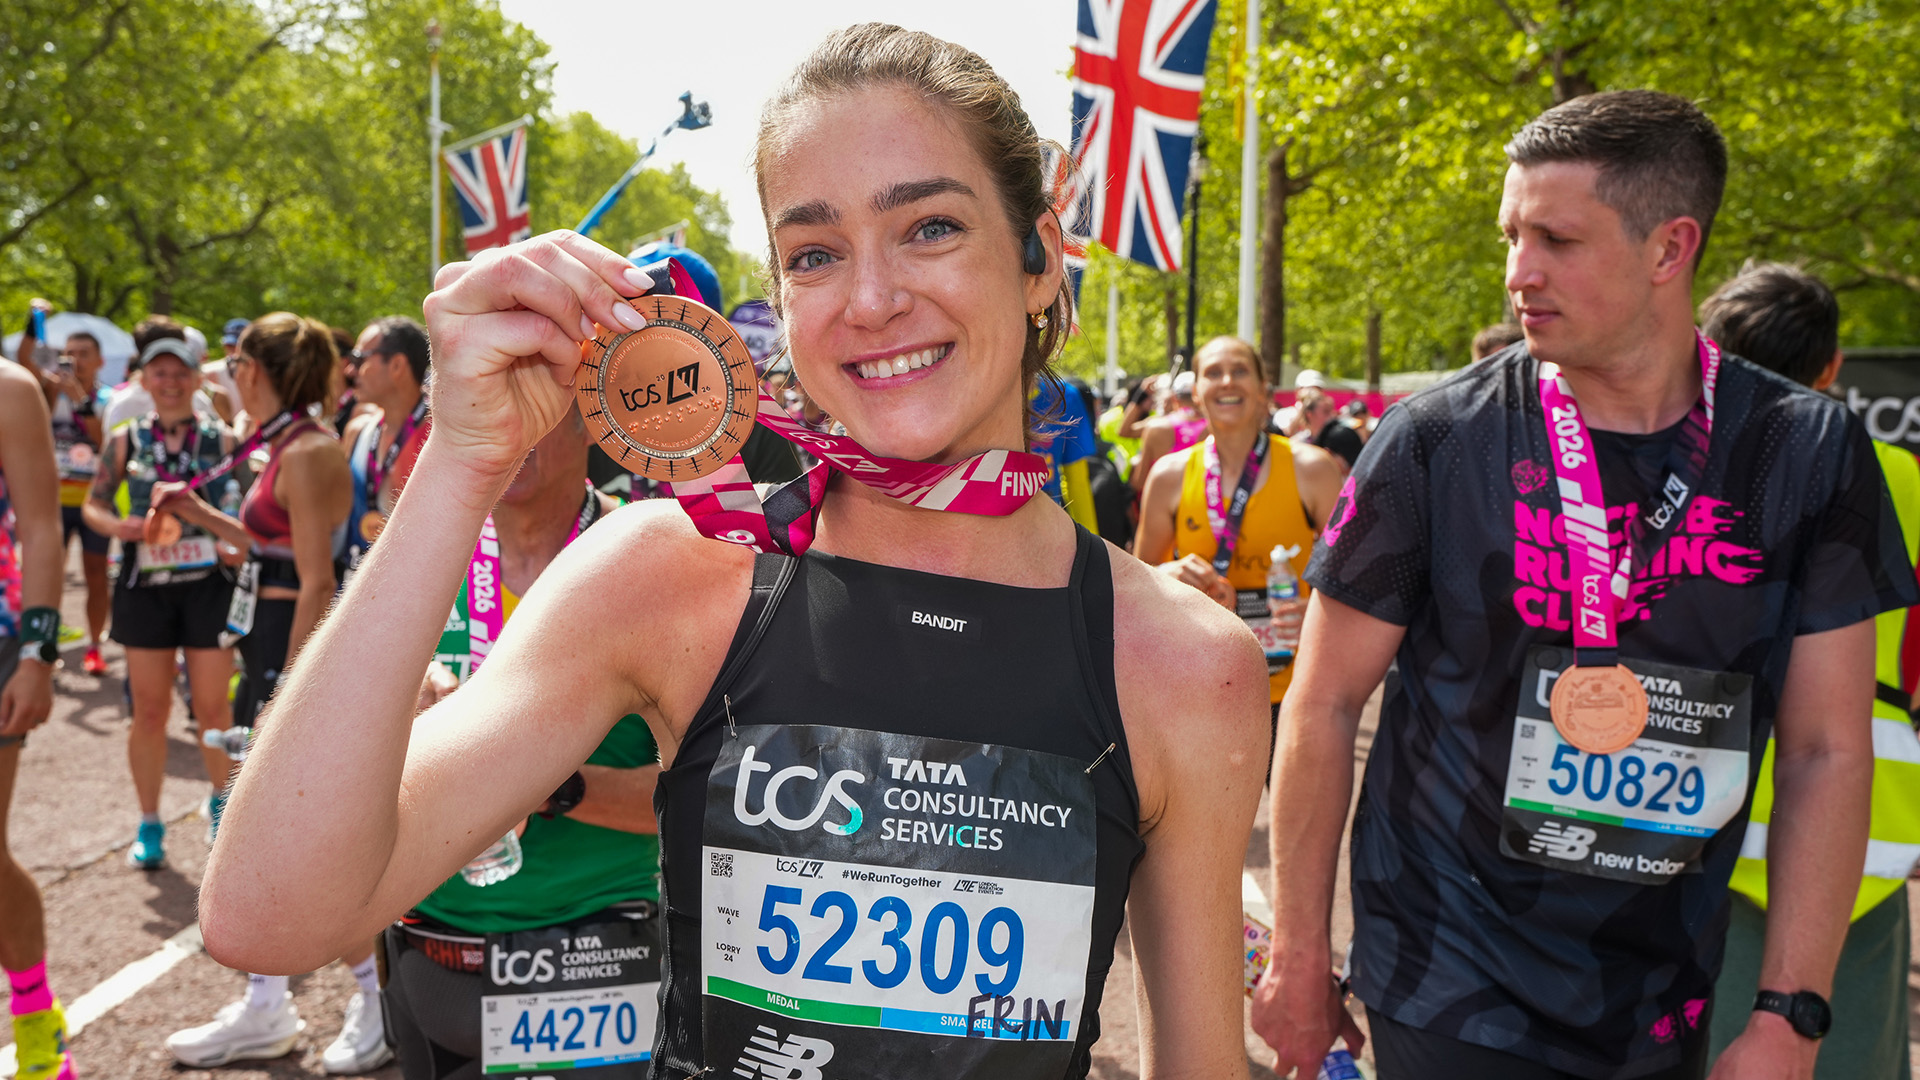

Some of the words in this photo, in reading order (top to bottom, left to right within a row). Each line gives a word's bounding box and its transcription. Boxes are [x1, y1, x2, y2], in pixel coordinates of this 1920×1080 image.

[619, 383, 661, 411] tcs
[1552, 403, 1587, 469] 2026
[1645, 503, 1676, 530] tcs
[473, 559, 496, 613] 2026
[1582, 574, 1600, 606] tcs
[911, 610, 968, 634] BANDIT
[1646, 711, 1702, 735] RVICES
[887, 756, 968, 787] TATA
[1548, 743, 1705, 815] 50829
[733, 745, 866, 836] tcs
[883, 787, 1073, 828] CONSULTANCY
[880, 817, 1004, 851] SERVICES
[776, 857, 799, 874] tcs
[1594, 851, 1634, 870] new
[842, 869, 942, 889] #WeRunTogether
[717, 906, 740, 918] WAVE
[726, 917, 732, 925] 6
[716, 942, 741, 955] LORRY
[756, 884, 1025, 997] 52309
[491, 943, 556, 986] tcs
[561, 946, 650, 967] CONSULTANCY
[723, 953, 734, 963] 24
[561, 962, 623, 982] SERVICES
[766, 992, 800, 1011] MEDAL
[511, 1001, 638, 1054] 44270
[966, 992, 1067, 1041] ERIN
